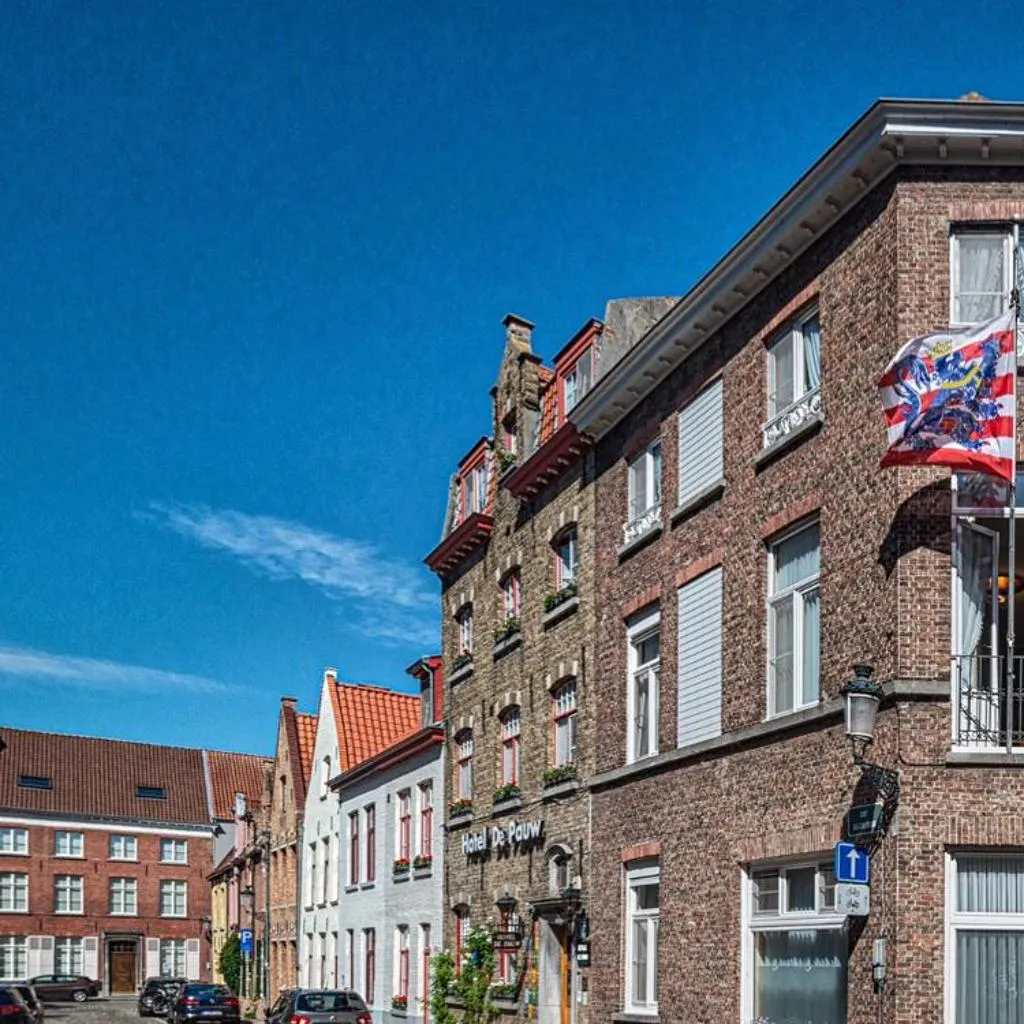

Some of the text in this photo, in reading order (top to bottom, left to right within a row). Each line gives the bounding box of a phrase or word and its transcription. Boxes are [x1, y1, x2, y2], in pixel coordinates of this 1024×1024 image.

[461, 819, 541, 855] Hotel De Pauw
[242, 930, 253, 943] P
